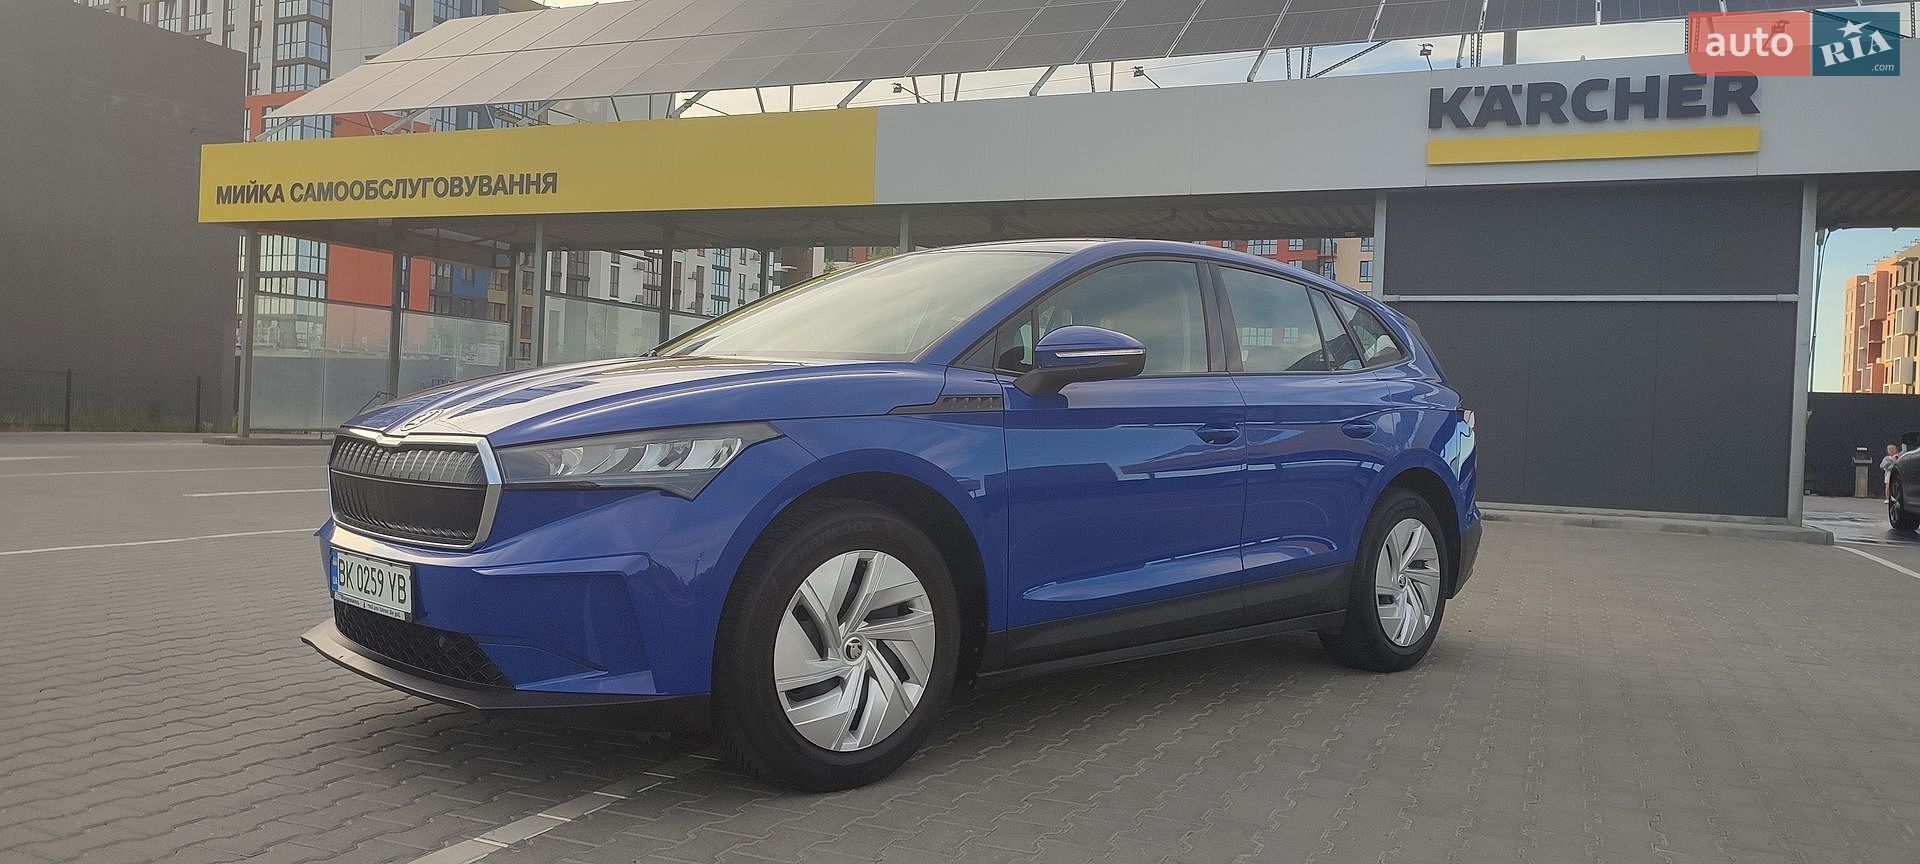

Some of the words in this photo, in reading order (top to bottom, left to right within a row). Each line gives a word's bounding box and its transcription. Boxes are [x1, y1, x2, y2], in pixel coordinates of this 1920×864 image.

[1428, 71, 1761, 129] KÄRCHER
[216, 180, 285, 205] МИЙКА
[290, 172, 558, 203] САМООБСЛУГОВУВАННЯ
[339, 558, 354, 590] BK
[357, 564, 384, 597] 0259
[388, 571, 407, 604] YB
